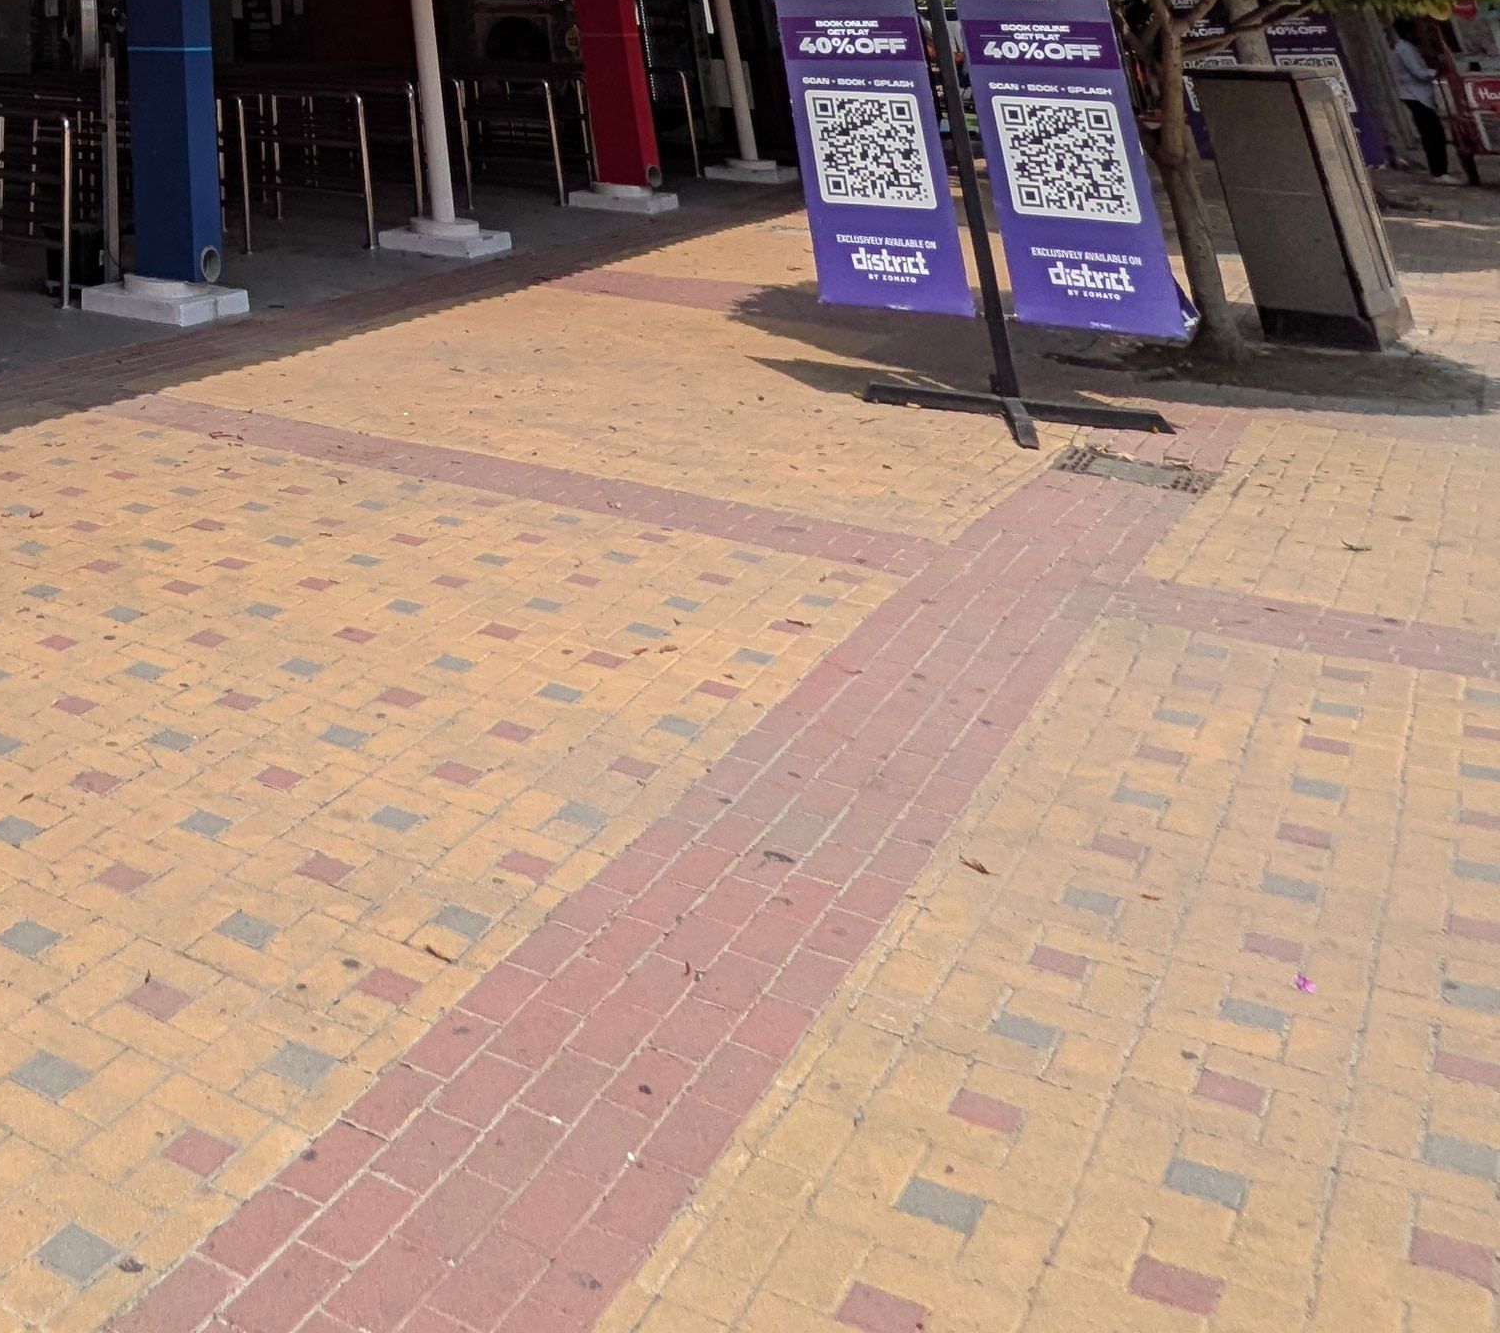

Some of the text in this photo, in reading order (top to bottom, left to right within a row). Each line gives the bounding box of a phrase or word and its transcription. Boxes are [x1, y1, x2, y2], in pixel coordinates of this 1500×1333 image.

[844, 20, 879, 28] ONLINE
[1000, 24, 1071, 33] BOOK ONLINE
[1034, 33, 1061, 41] FLAT
[802, 77, 915, 88] SCAN BOOK SPLASH
[988, 82, 1112, 96] SCAN BOOK SPLASH
[836, 233, 938, 250] EXCLUSIVELY AVAILABLE ON
[850, 246, 931, 275] district
[1030, 246, 1143, 266] EXCLUSIVELY AVAILABLE ON
[868, 273, 879, 281] BY
[1047, 261, 1135, 293] district
